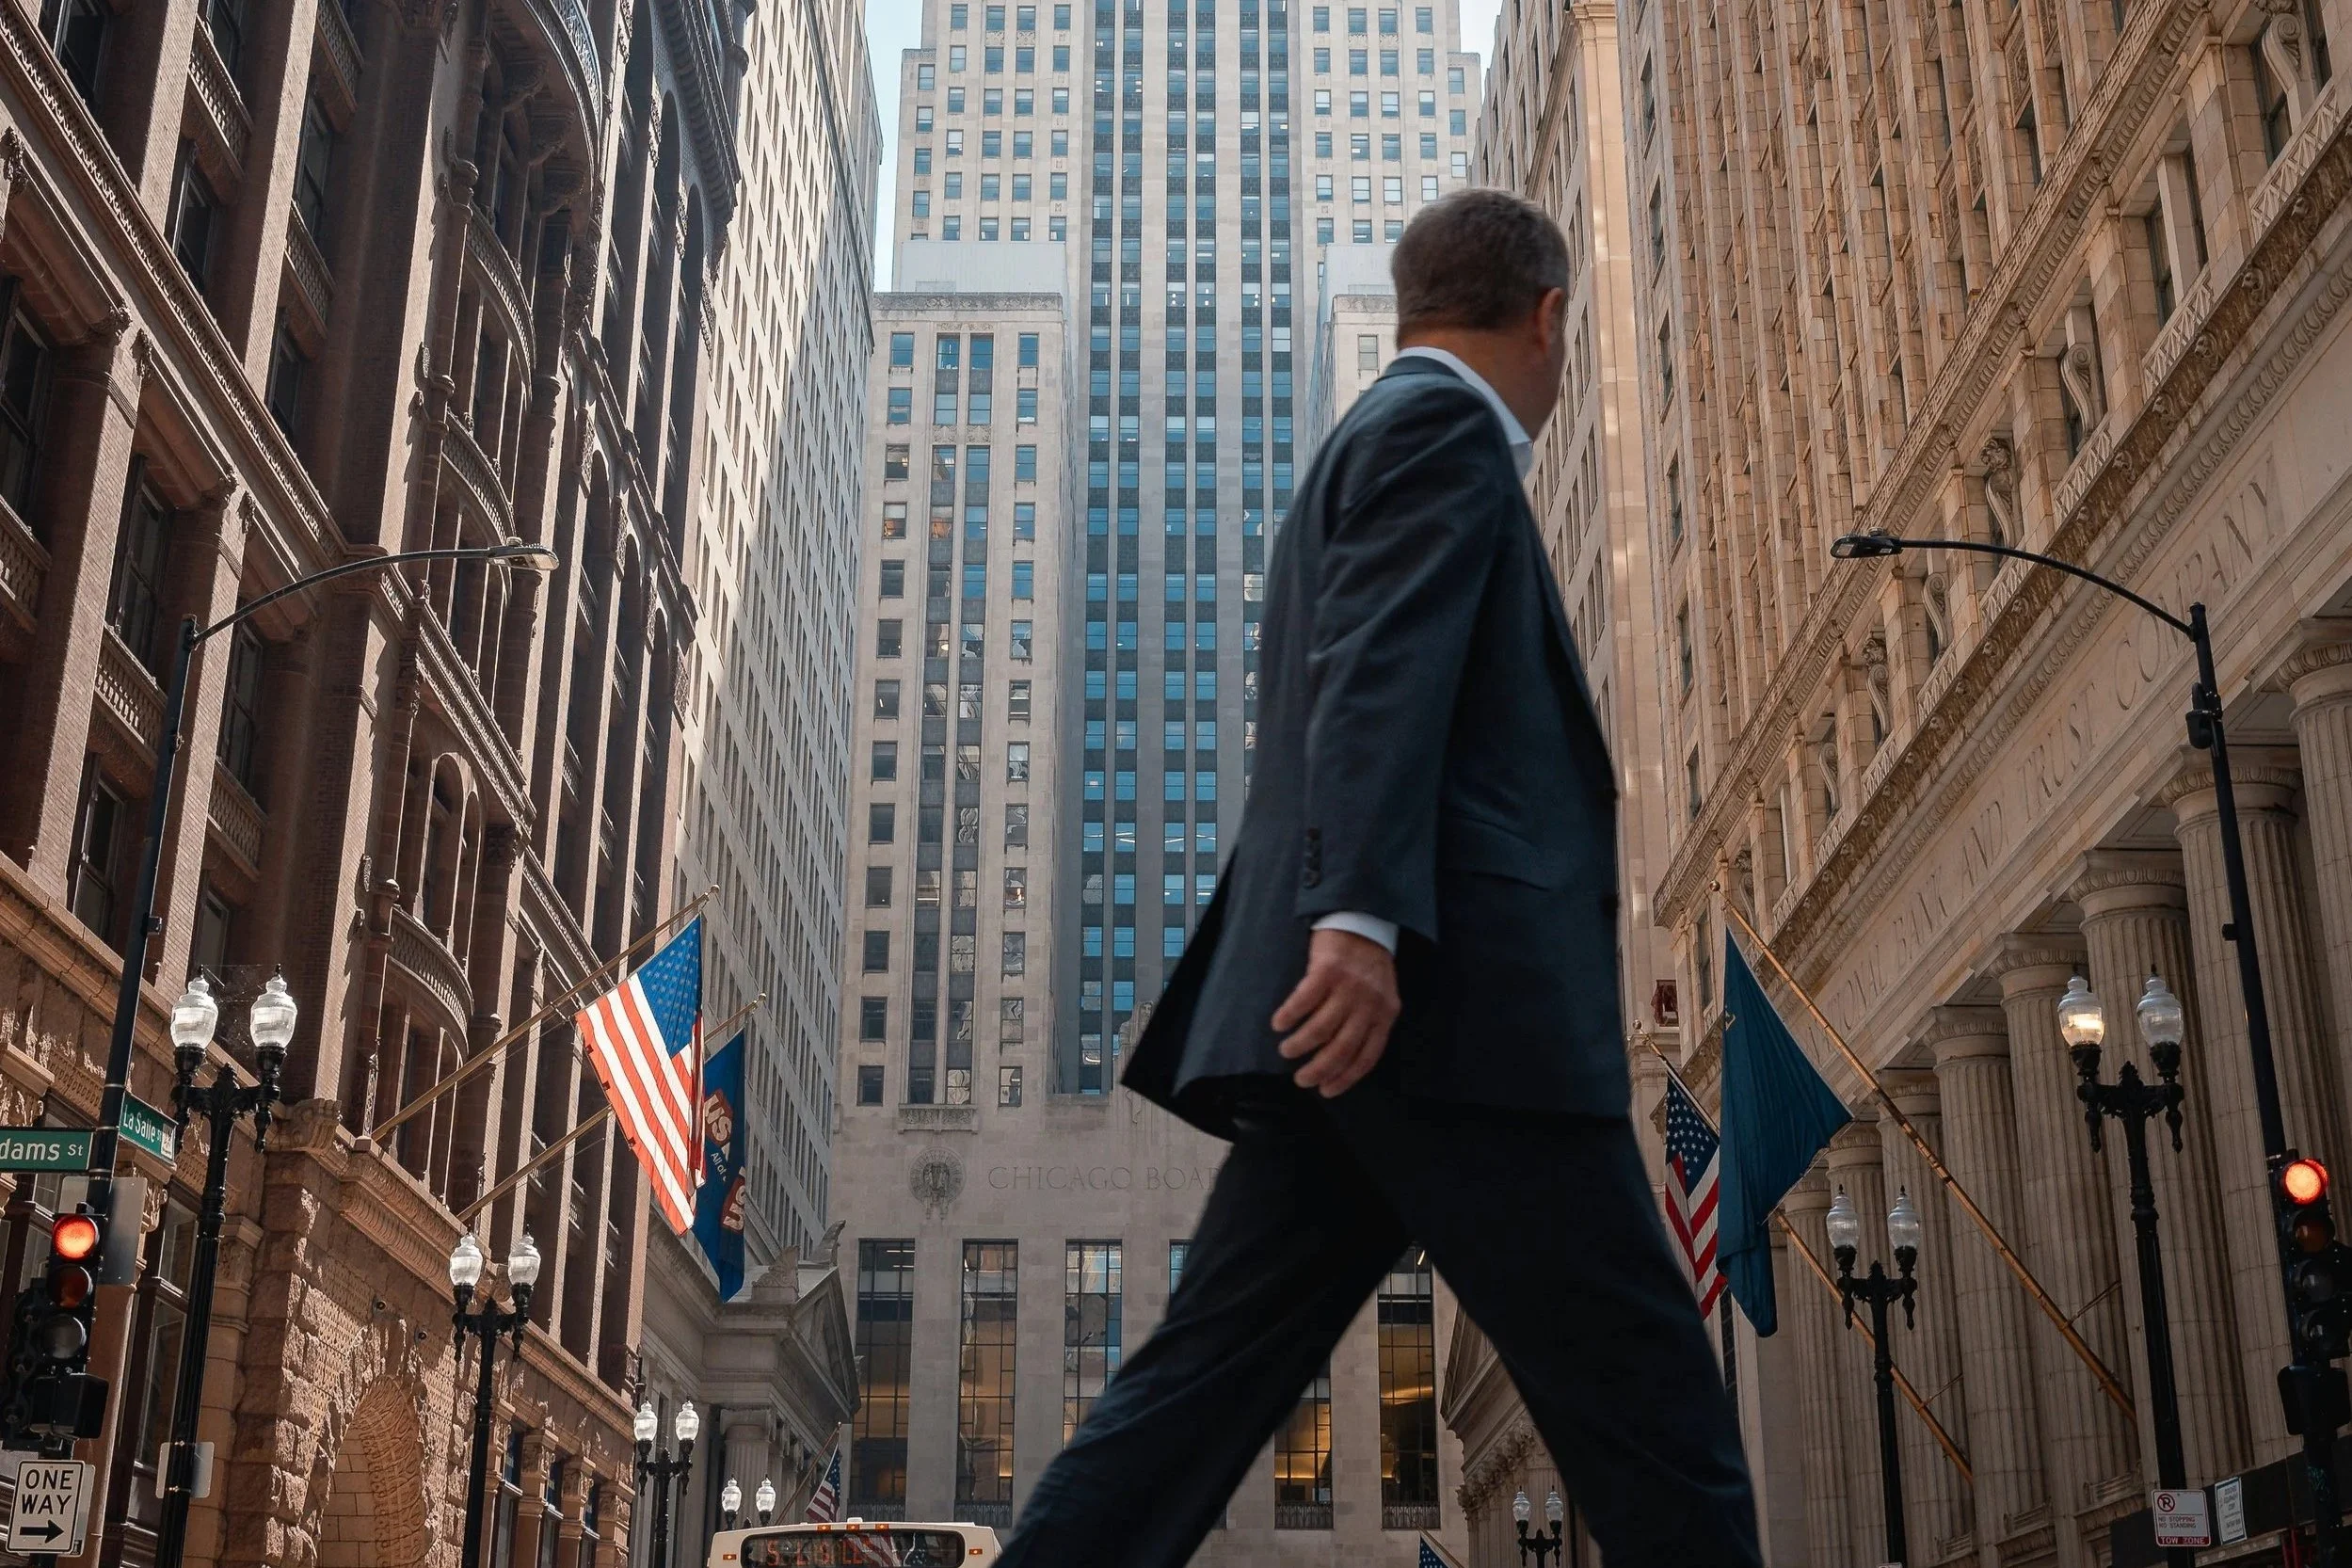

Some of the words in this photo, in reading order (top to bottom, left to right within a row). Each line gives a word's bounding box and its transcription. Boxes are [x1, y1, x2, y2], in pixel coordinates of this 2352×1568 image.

[1892, 865, 1948, 973] BANK
[1960, 800, 2003, 901] AND
[2017, 681, 2096, 823] TRUST
[2114, 446, 2276, 711] COMPANY
[0, 1137, 61, 1161] dams
[67, 1144, 84, 1157] St
[711, 1152, 723, 1166] All
[988, 1166, 1131, 1191] CHICAGO
[25, 1469, 73, 1490] ONE
[22, 1495, 72, 1514] WAY
